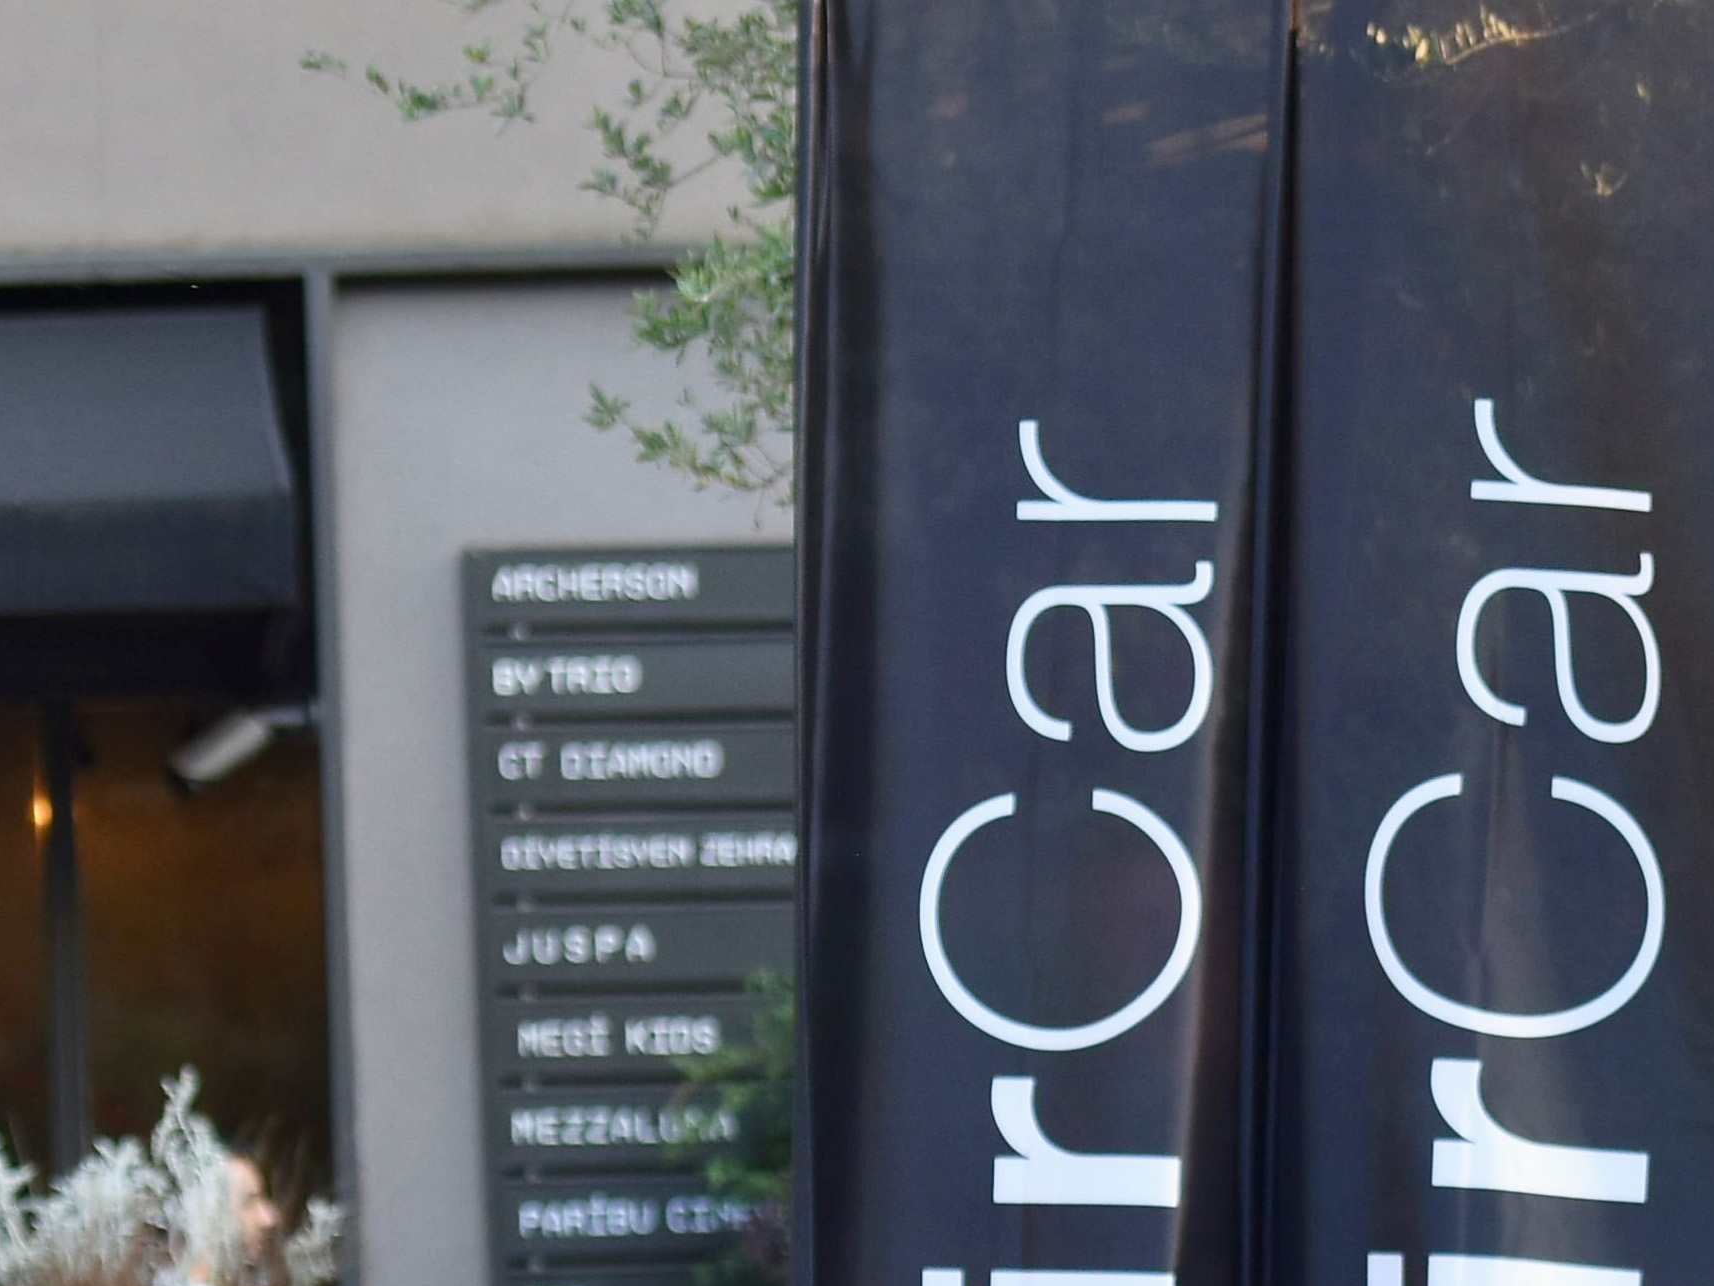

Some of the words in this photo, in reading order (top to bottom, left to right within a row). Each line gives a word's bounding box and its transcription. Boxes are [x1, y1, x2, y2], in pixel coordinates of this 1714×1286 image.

[491, 562, 700, 601] ARCHERSON
[560, 739, 726, 780] DIAMOND
[502, 923, 658, 965] JUSPA
[625, 1015, 722, 1055] KIDS
